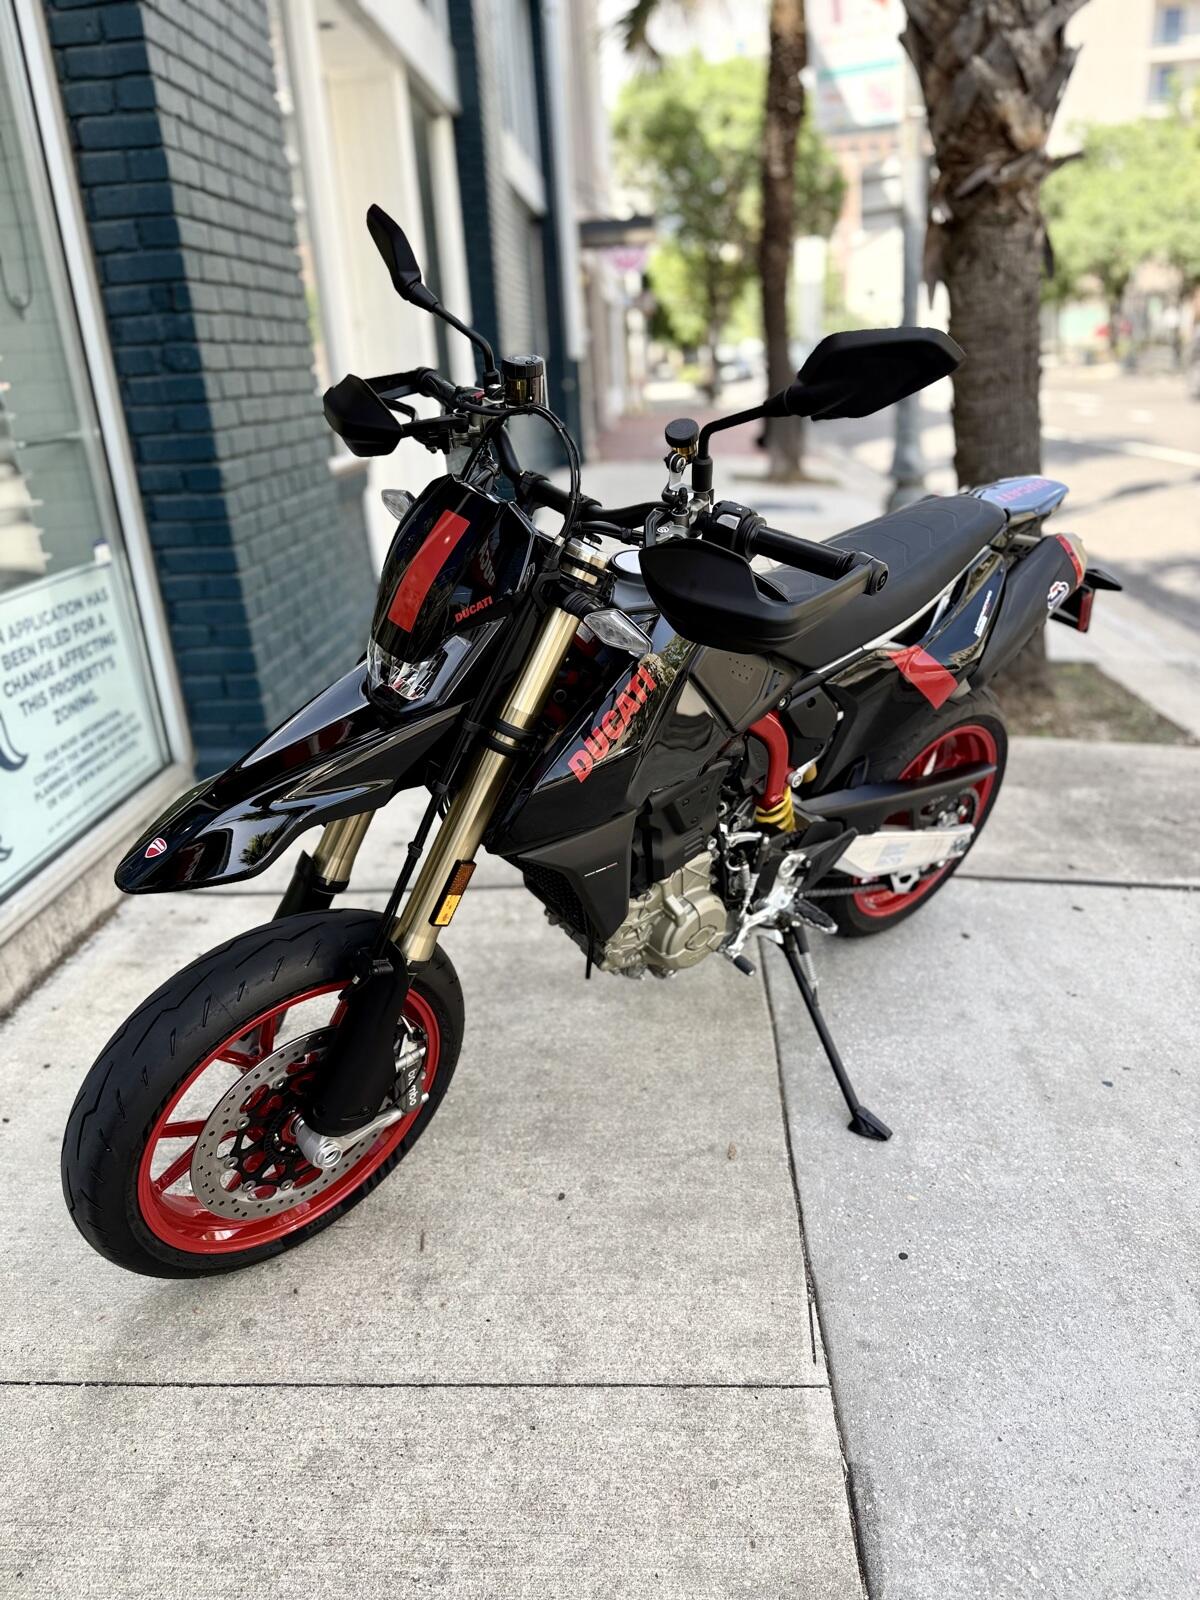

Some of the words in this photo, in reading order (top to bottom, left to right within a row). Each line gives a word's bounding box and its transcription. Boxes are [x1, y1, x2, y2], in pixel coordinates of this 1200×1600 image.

[8, 599, 84, 642] APPLICATION
[85, 586, 108, 607] HAS
[454, 596, 493, 623] DUCATI
[1, 644, 37, 671] BEEN
[38, 627, 72, 654] FILED
[73, 615, 95, 637] FOR
[98, 612, 106, 627] A
[3, 660, 56, 698] CHANGE
[58, 629, 117, 670] AFFECTING
[18, 690, 48, 718] THIS
[53, 687, 100, 726] ZONING
[567, 665, 657, 783] DUCATI
